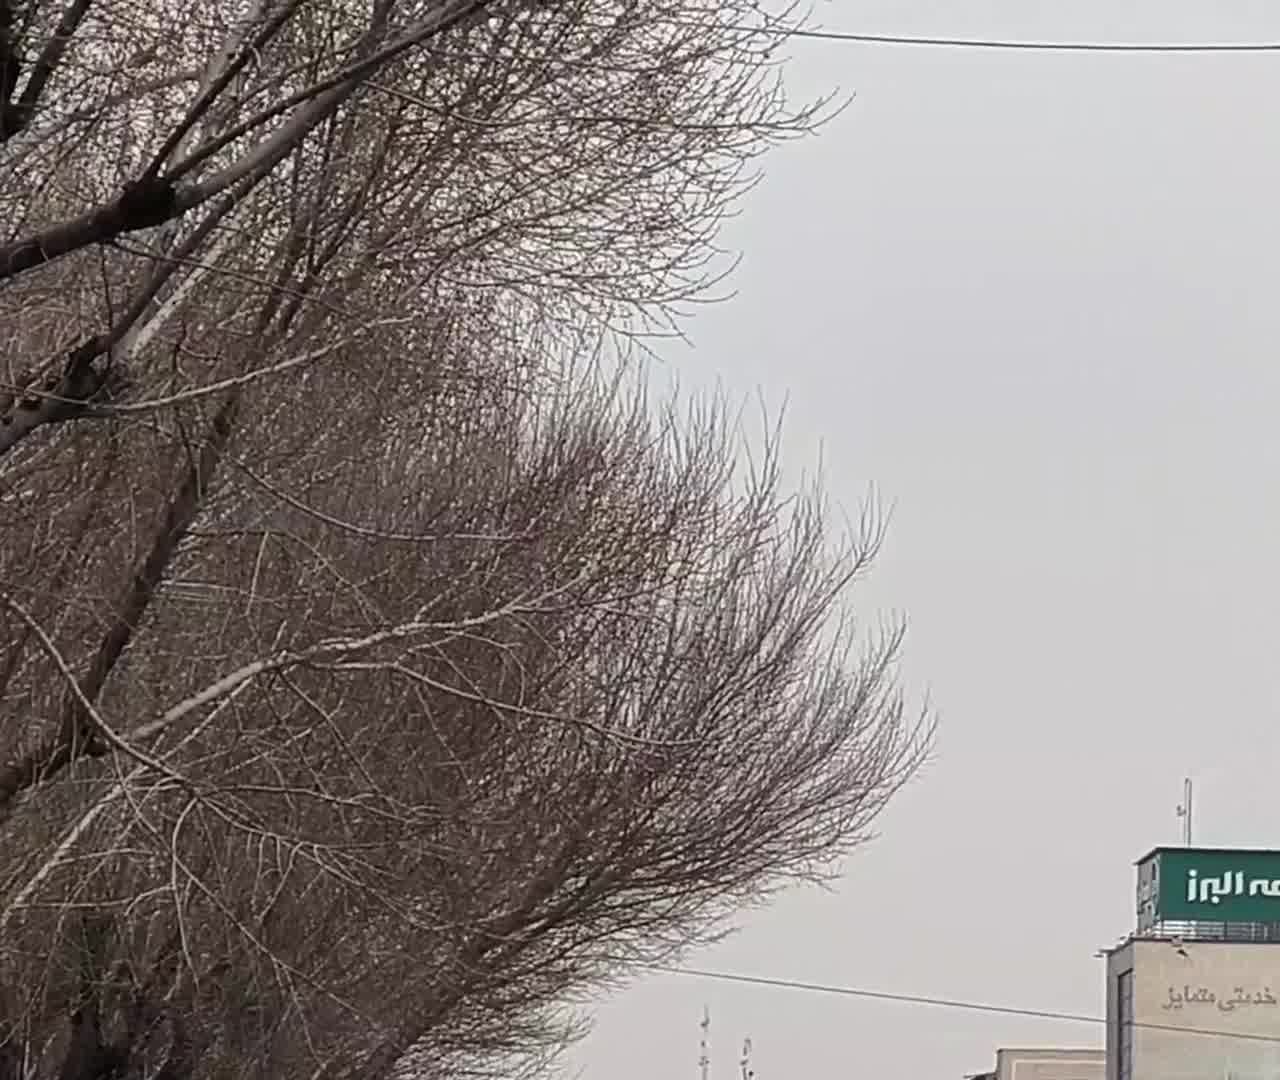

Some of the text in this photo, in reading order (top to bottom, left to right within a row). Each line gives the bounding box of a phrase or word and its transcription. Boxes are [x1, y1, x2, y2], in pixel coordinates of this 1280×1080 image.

[1187, 869, 1244, 904] البرز
[1161, 985, 1215, 1010] متمایز
[1217, 986, 1276, 1011] خدمتی
